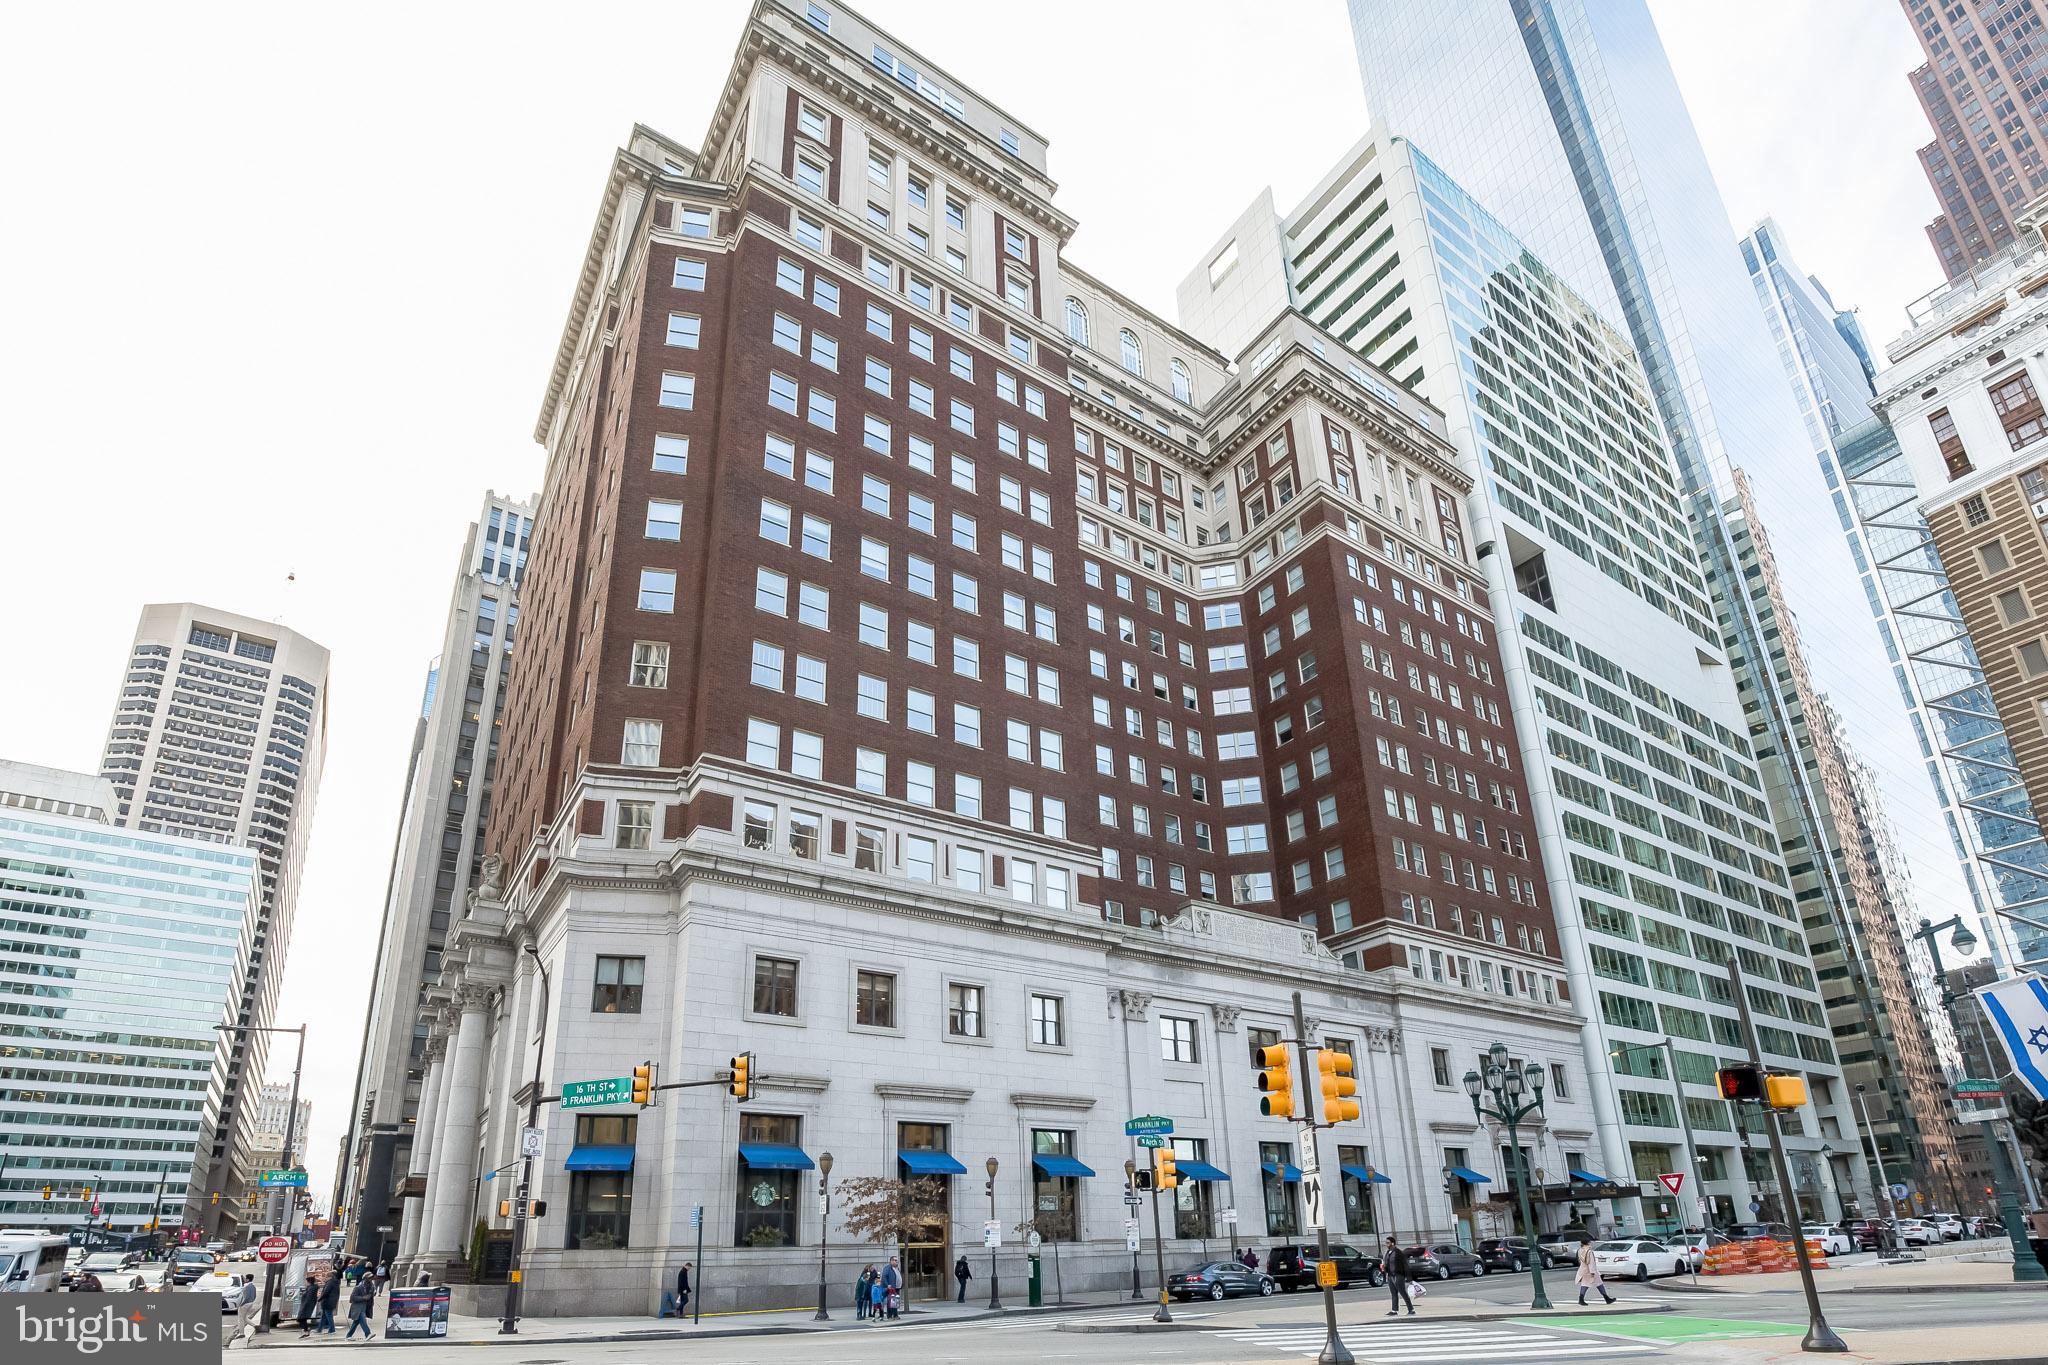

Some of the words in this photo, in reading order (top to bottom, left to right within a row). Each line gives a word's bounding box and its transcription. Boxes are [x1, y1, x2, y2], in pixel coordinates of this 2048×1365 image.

[577, 1085, 583, 1093] 16
[587, 1084, 596, 1092] TH
[600, 1082, 608, 1091] ST
[562, 1097, 567, 1105] B
[570, 1094, 604, 1105] FRANKLIN
[606, 1092, 621, 1101] PKY
[1135, 1120, 1159, 1129] FRANKLIN
